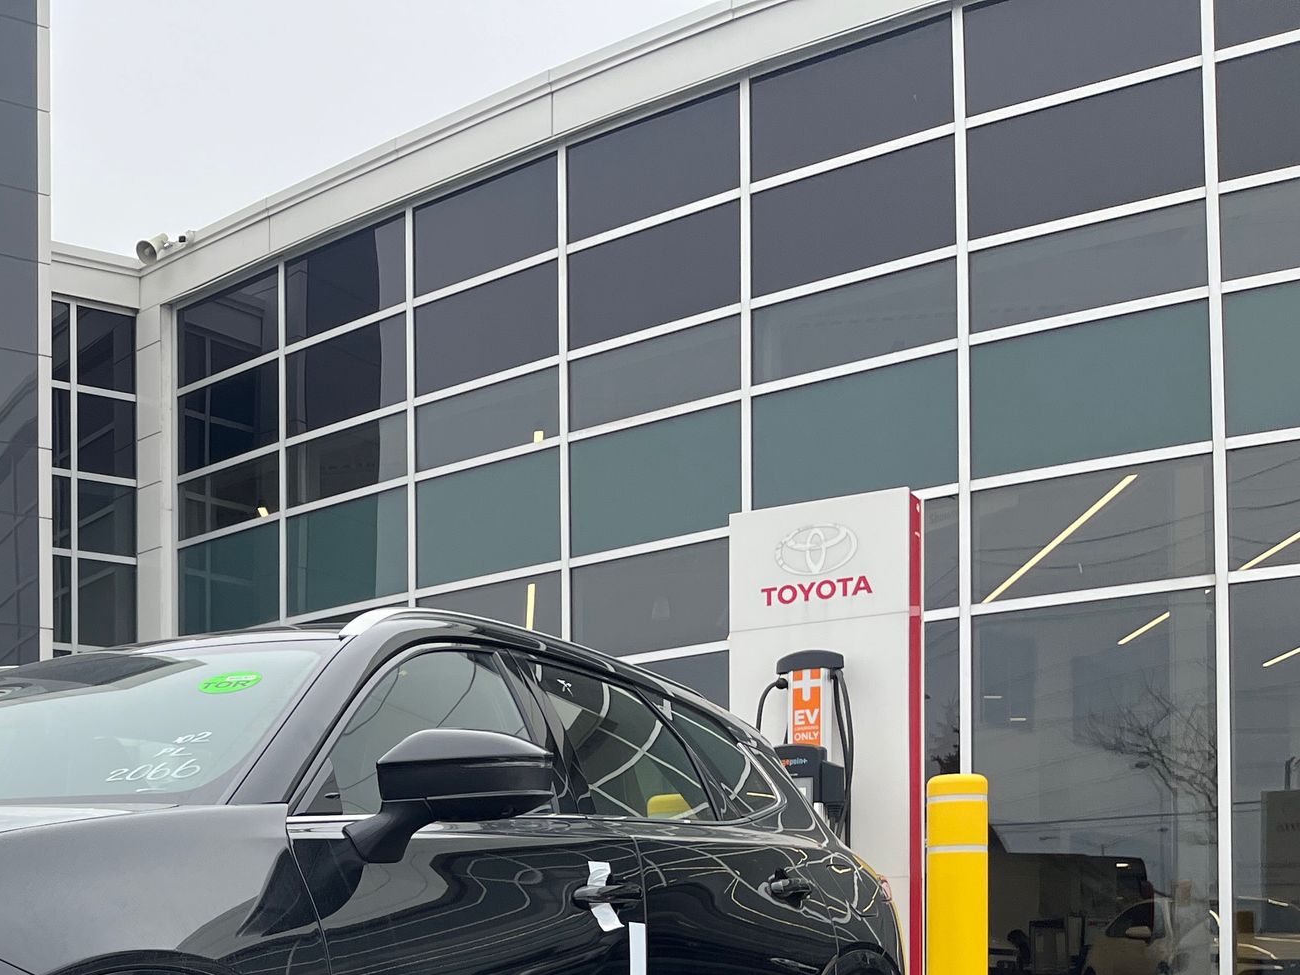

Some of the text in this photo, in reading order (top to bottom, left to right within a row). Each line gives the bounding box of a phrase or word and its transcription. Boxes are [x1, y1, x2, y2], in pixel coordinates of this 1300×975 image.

[761, 576, 873, 606] TOYOTA
[794, 709, 819, 725] EV
[794, 731, 819, 741] ONLY
[105, 758, 201, 782] 2066
